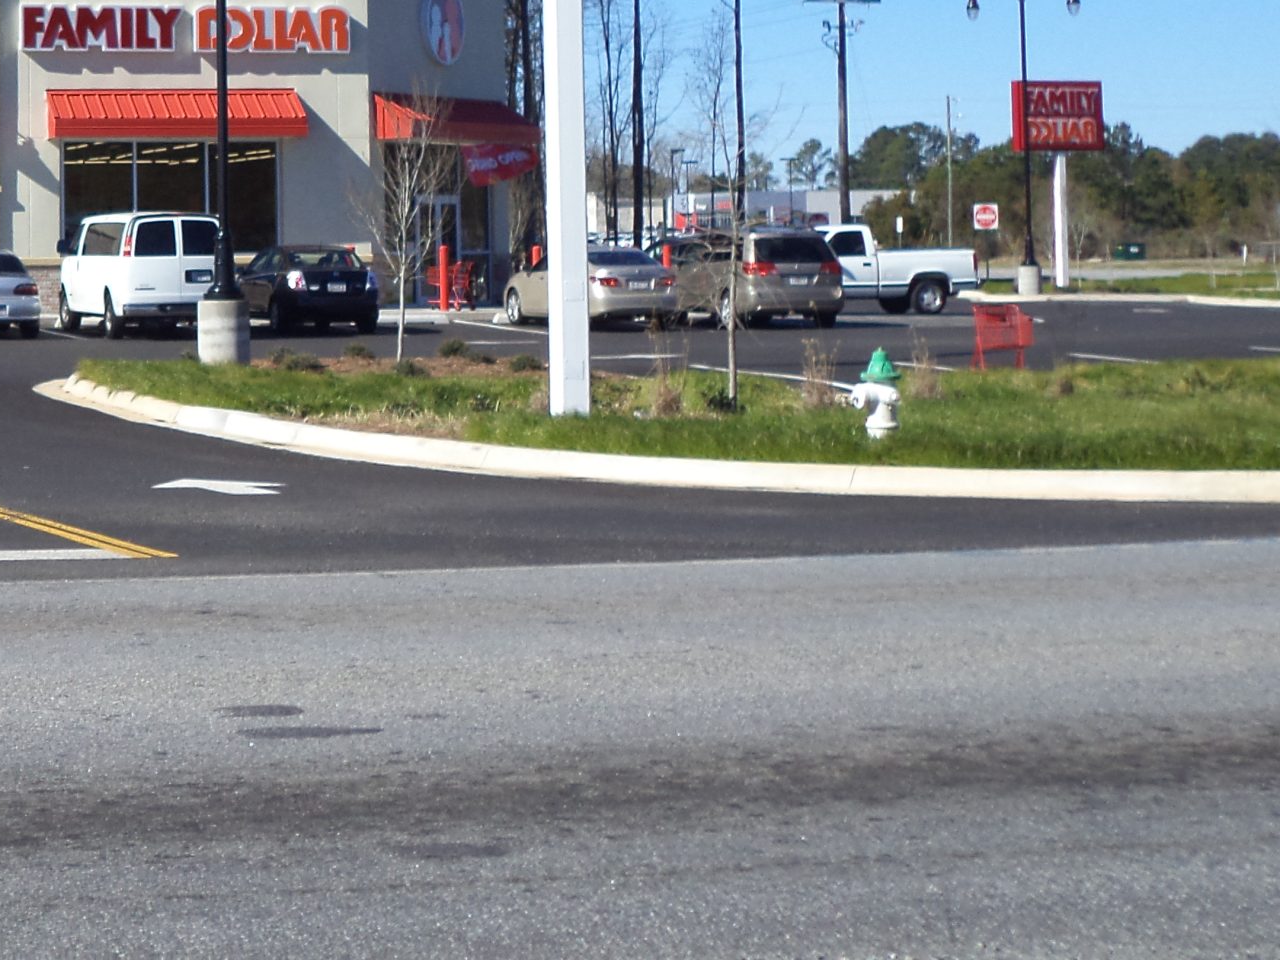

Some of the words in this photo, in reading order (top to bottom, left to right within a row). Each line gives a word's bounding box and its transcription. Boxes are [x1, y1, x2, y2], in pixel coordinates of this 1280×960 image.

[21, 5, 183, 52] FAMILY
[194, 5, 350, 53] DOLLAR
[1025, 87, 1099, 113] FAMILY
